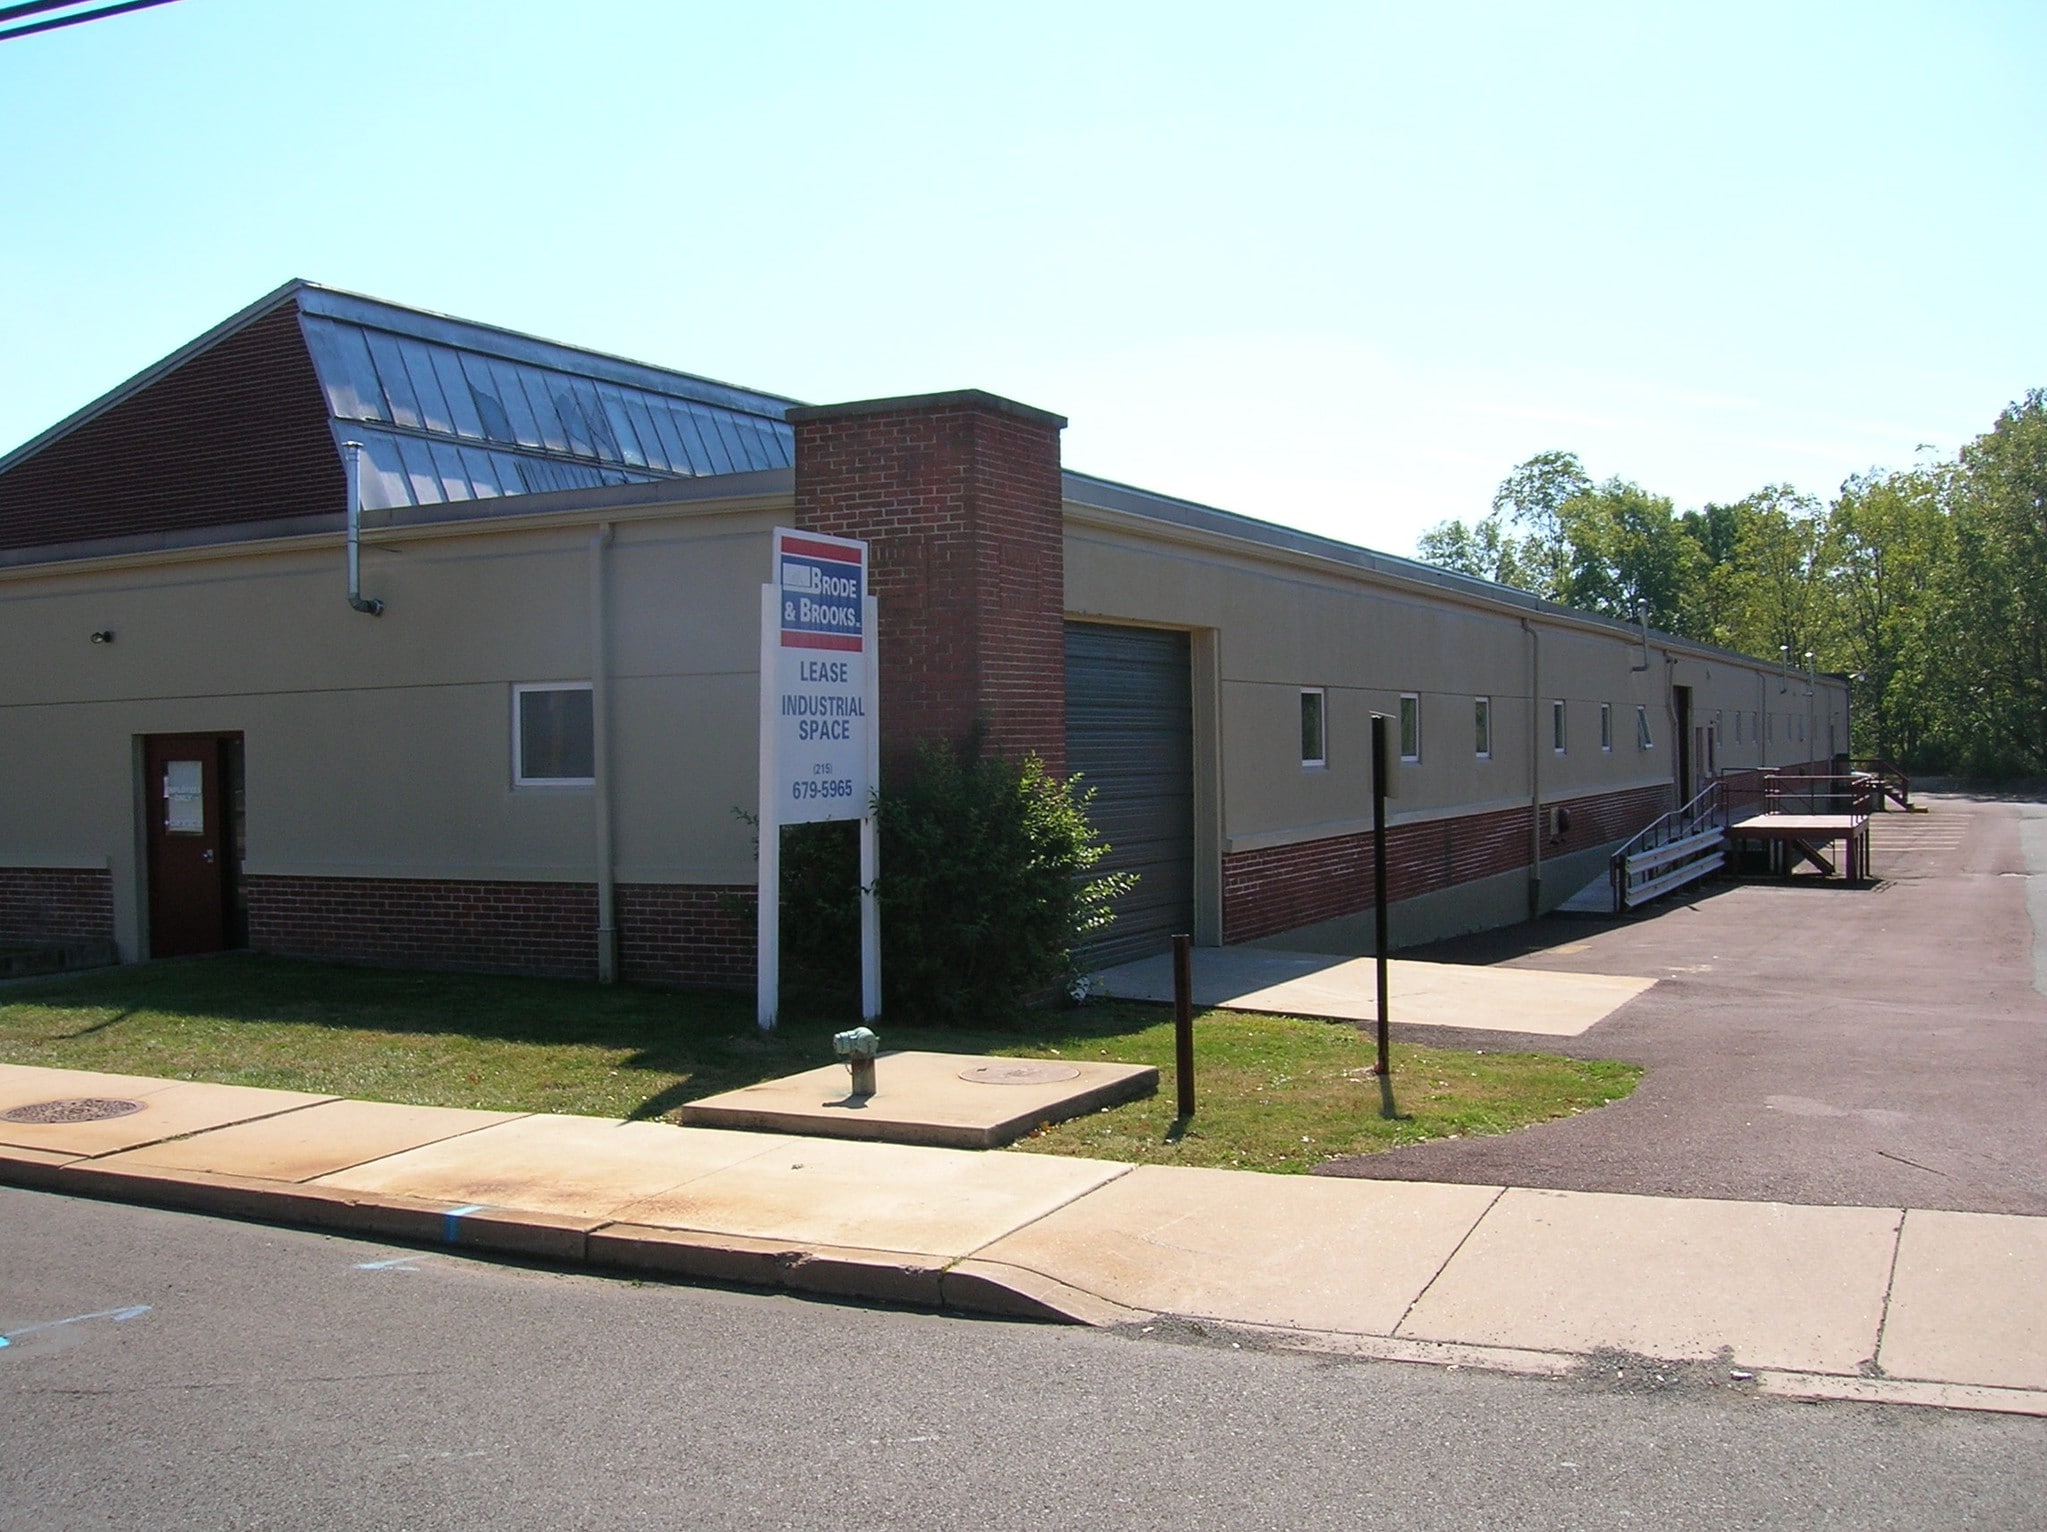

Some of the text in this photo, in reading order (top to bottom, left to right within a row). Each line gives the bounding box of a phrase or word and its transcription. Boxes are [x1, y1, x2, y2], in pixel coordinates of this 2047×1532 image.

[811, 566, 857, 598] BRODE
[784, 601, 796, 621] &
[800, 661, 848, 683] LEASE
[782, 694, 865, 717] INDUSTRIAL
[799, 719, 850, 741] SPACE
[813, 763, 833, 775] (215)
[792, 780, 853, 800] 679-5965
